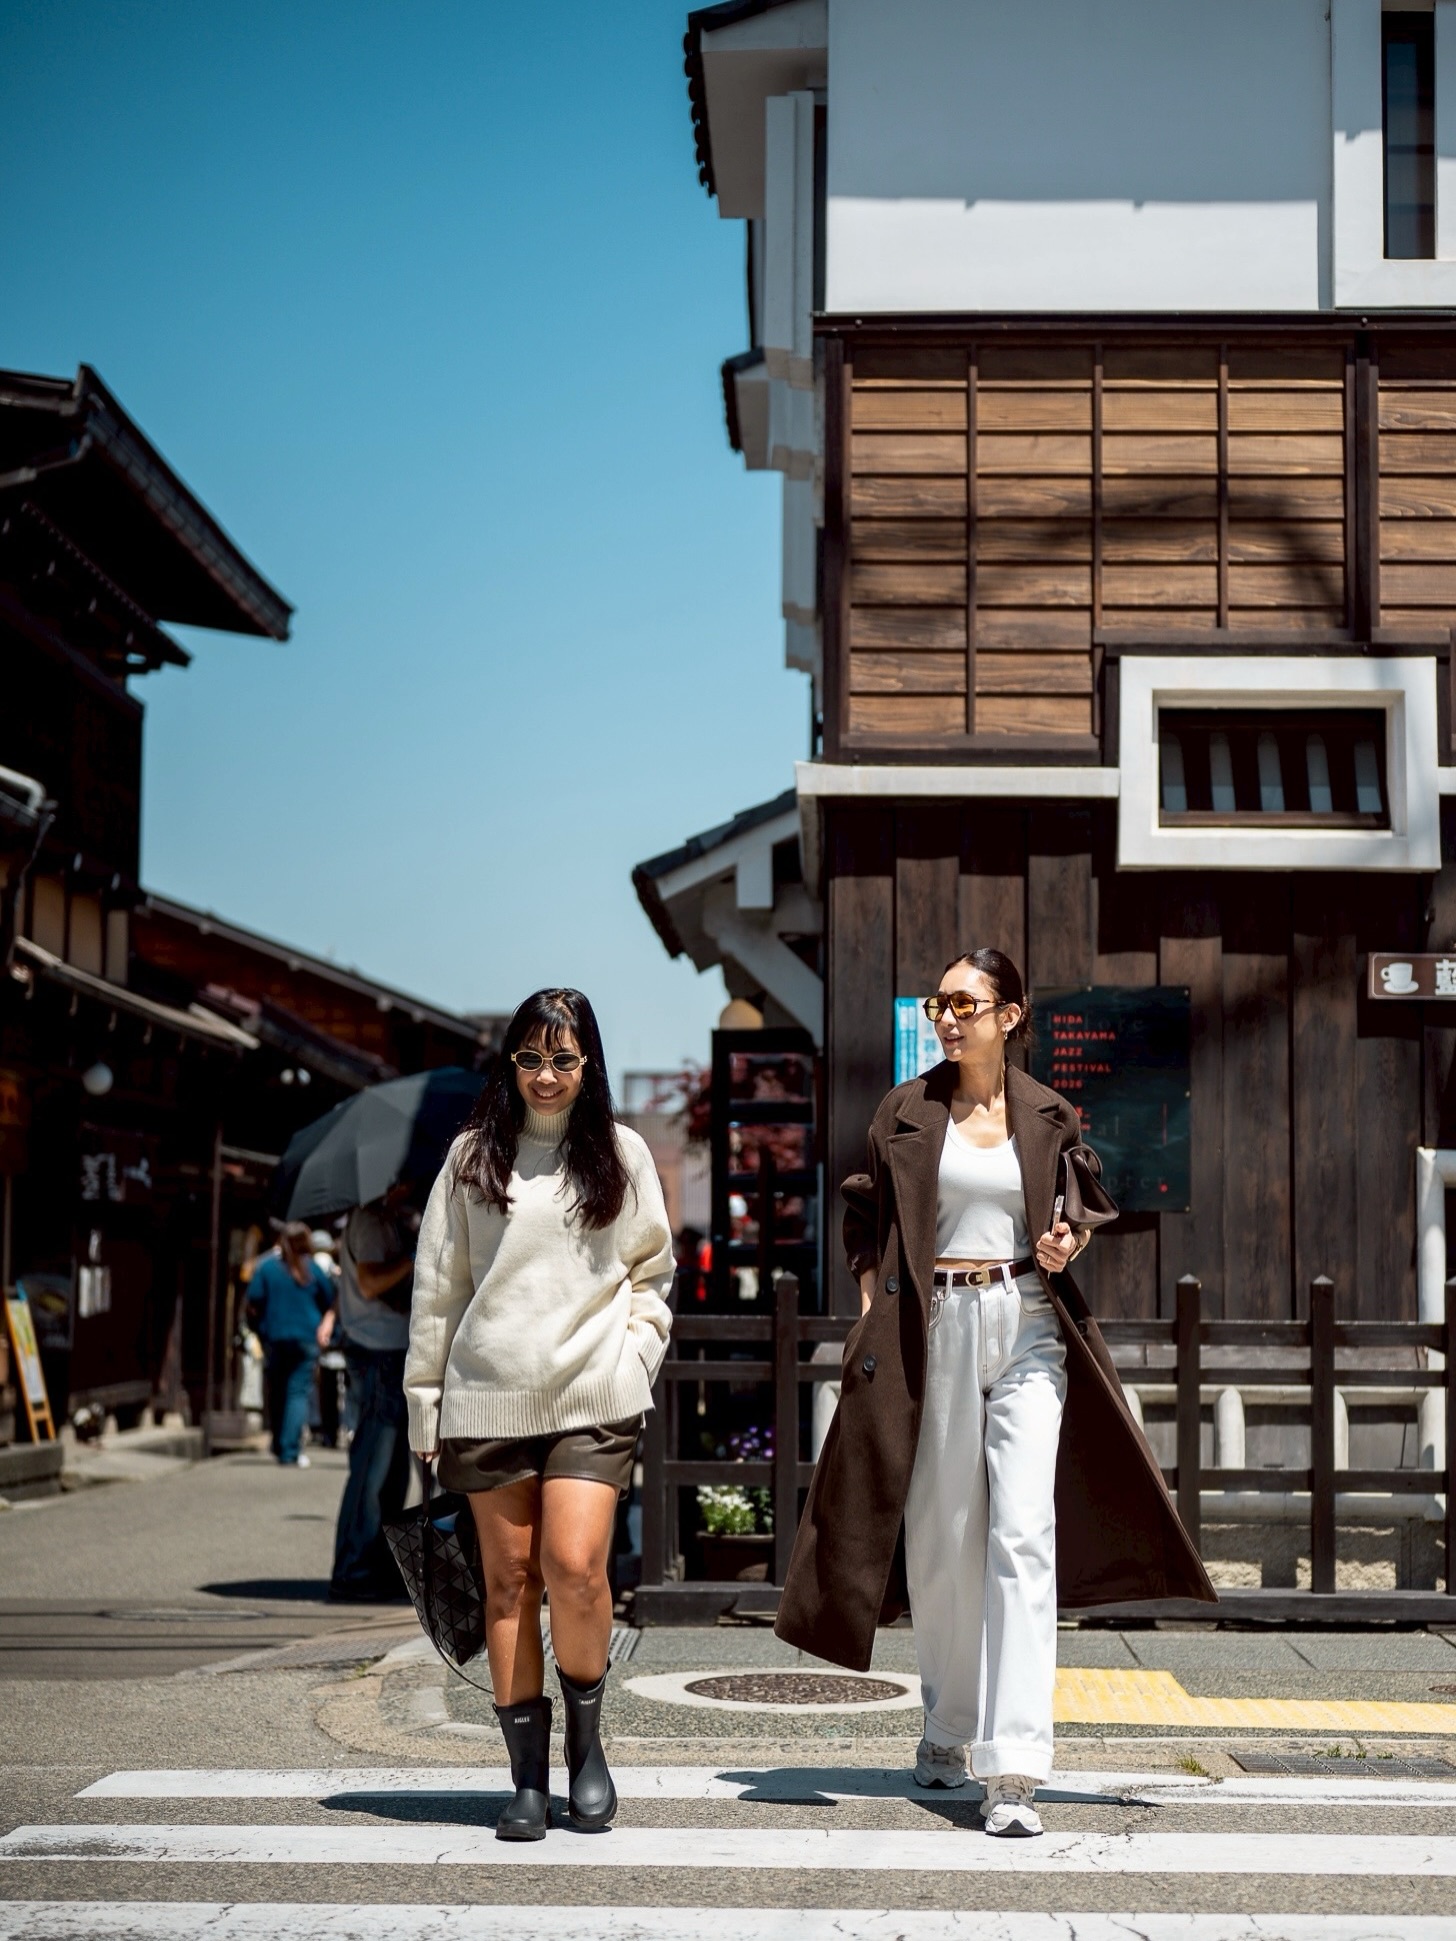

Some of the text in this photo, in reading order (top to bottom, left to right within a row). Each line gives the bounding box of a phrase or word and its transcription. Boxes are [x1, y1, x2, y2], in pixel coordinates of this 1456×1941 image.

[1053, 1014, 1083, 1025] HIDA
[1053, 1030, 1116, 1041] TAKAYAMA
[1053, 1047, 1083, 1057] JAZZ
[1053, 1062, 1112, 1072] FESTIVAL
